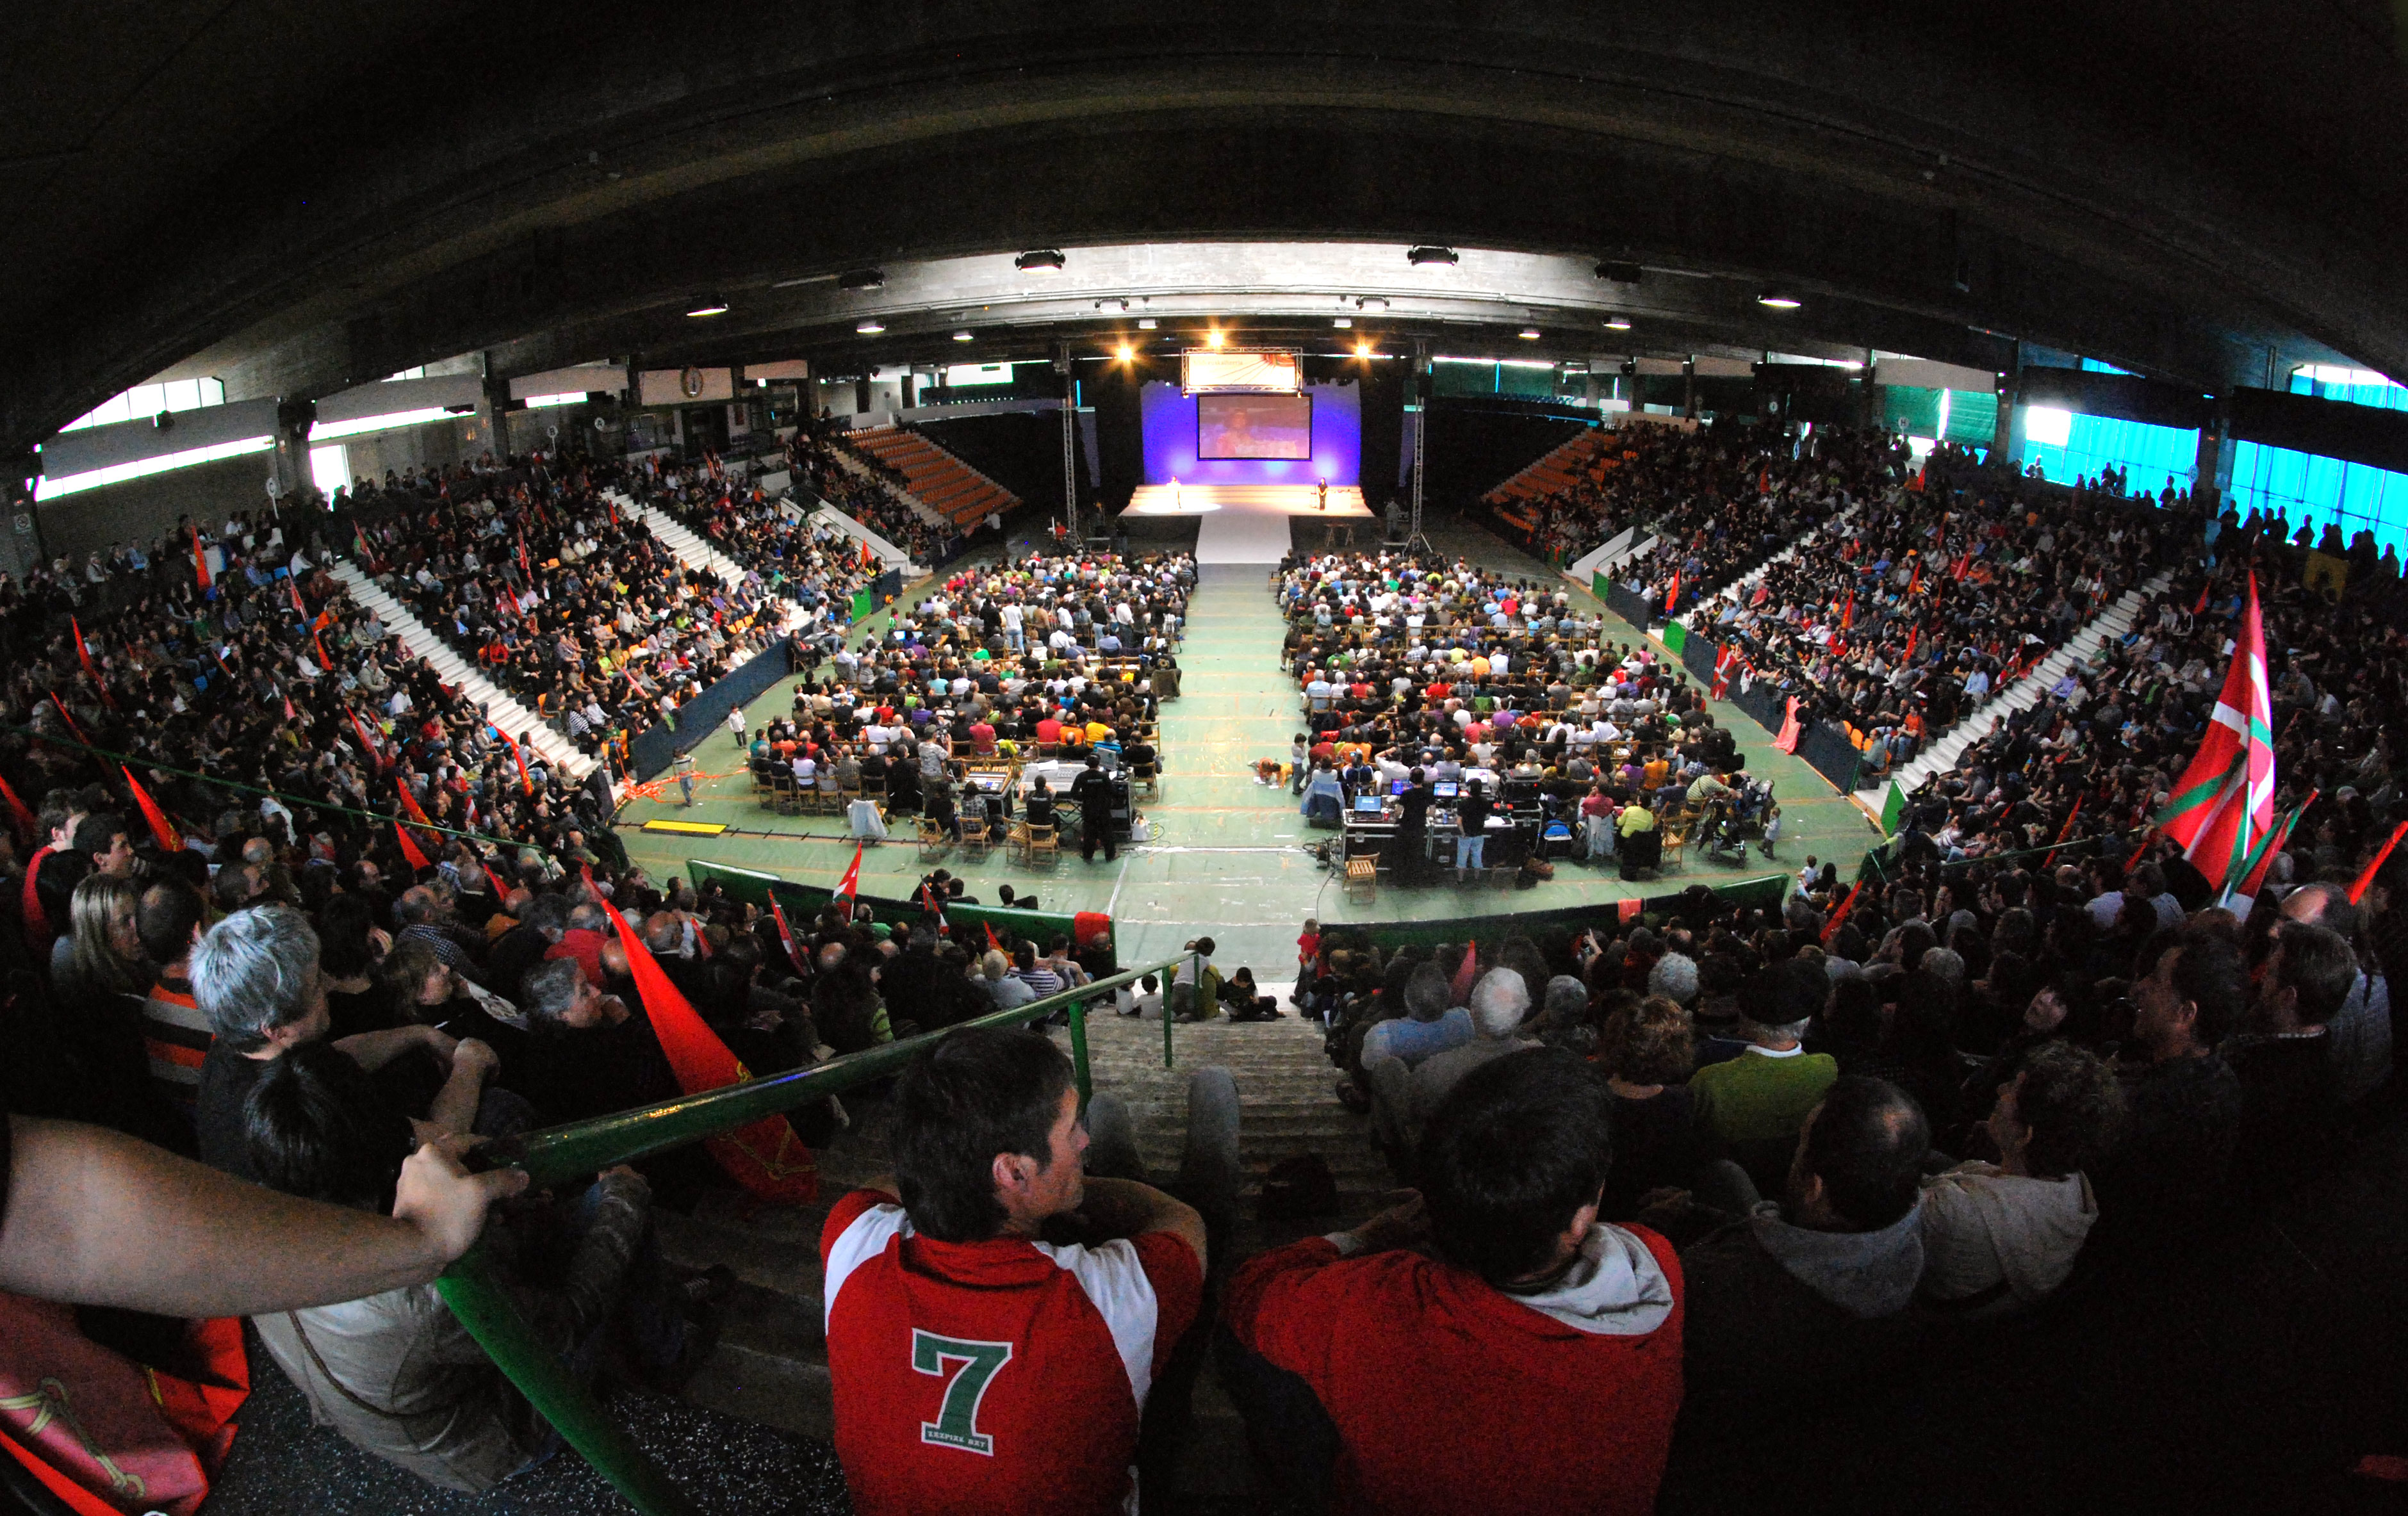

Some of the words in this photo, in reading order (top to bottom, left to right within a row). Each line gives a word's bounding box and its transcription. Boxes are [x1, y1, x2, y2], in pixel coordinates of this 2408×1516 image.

[269, 482, 275, 493] C
[912, 1327, 1013, 1456] 7
[967, 1438, 986, 1448] BAT
